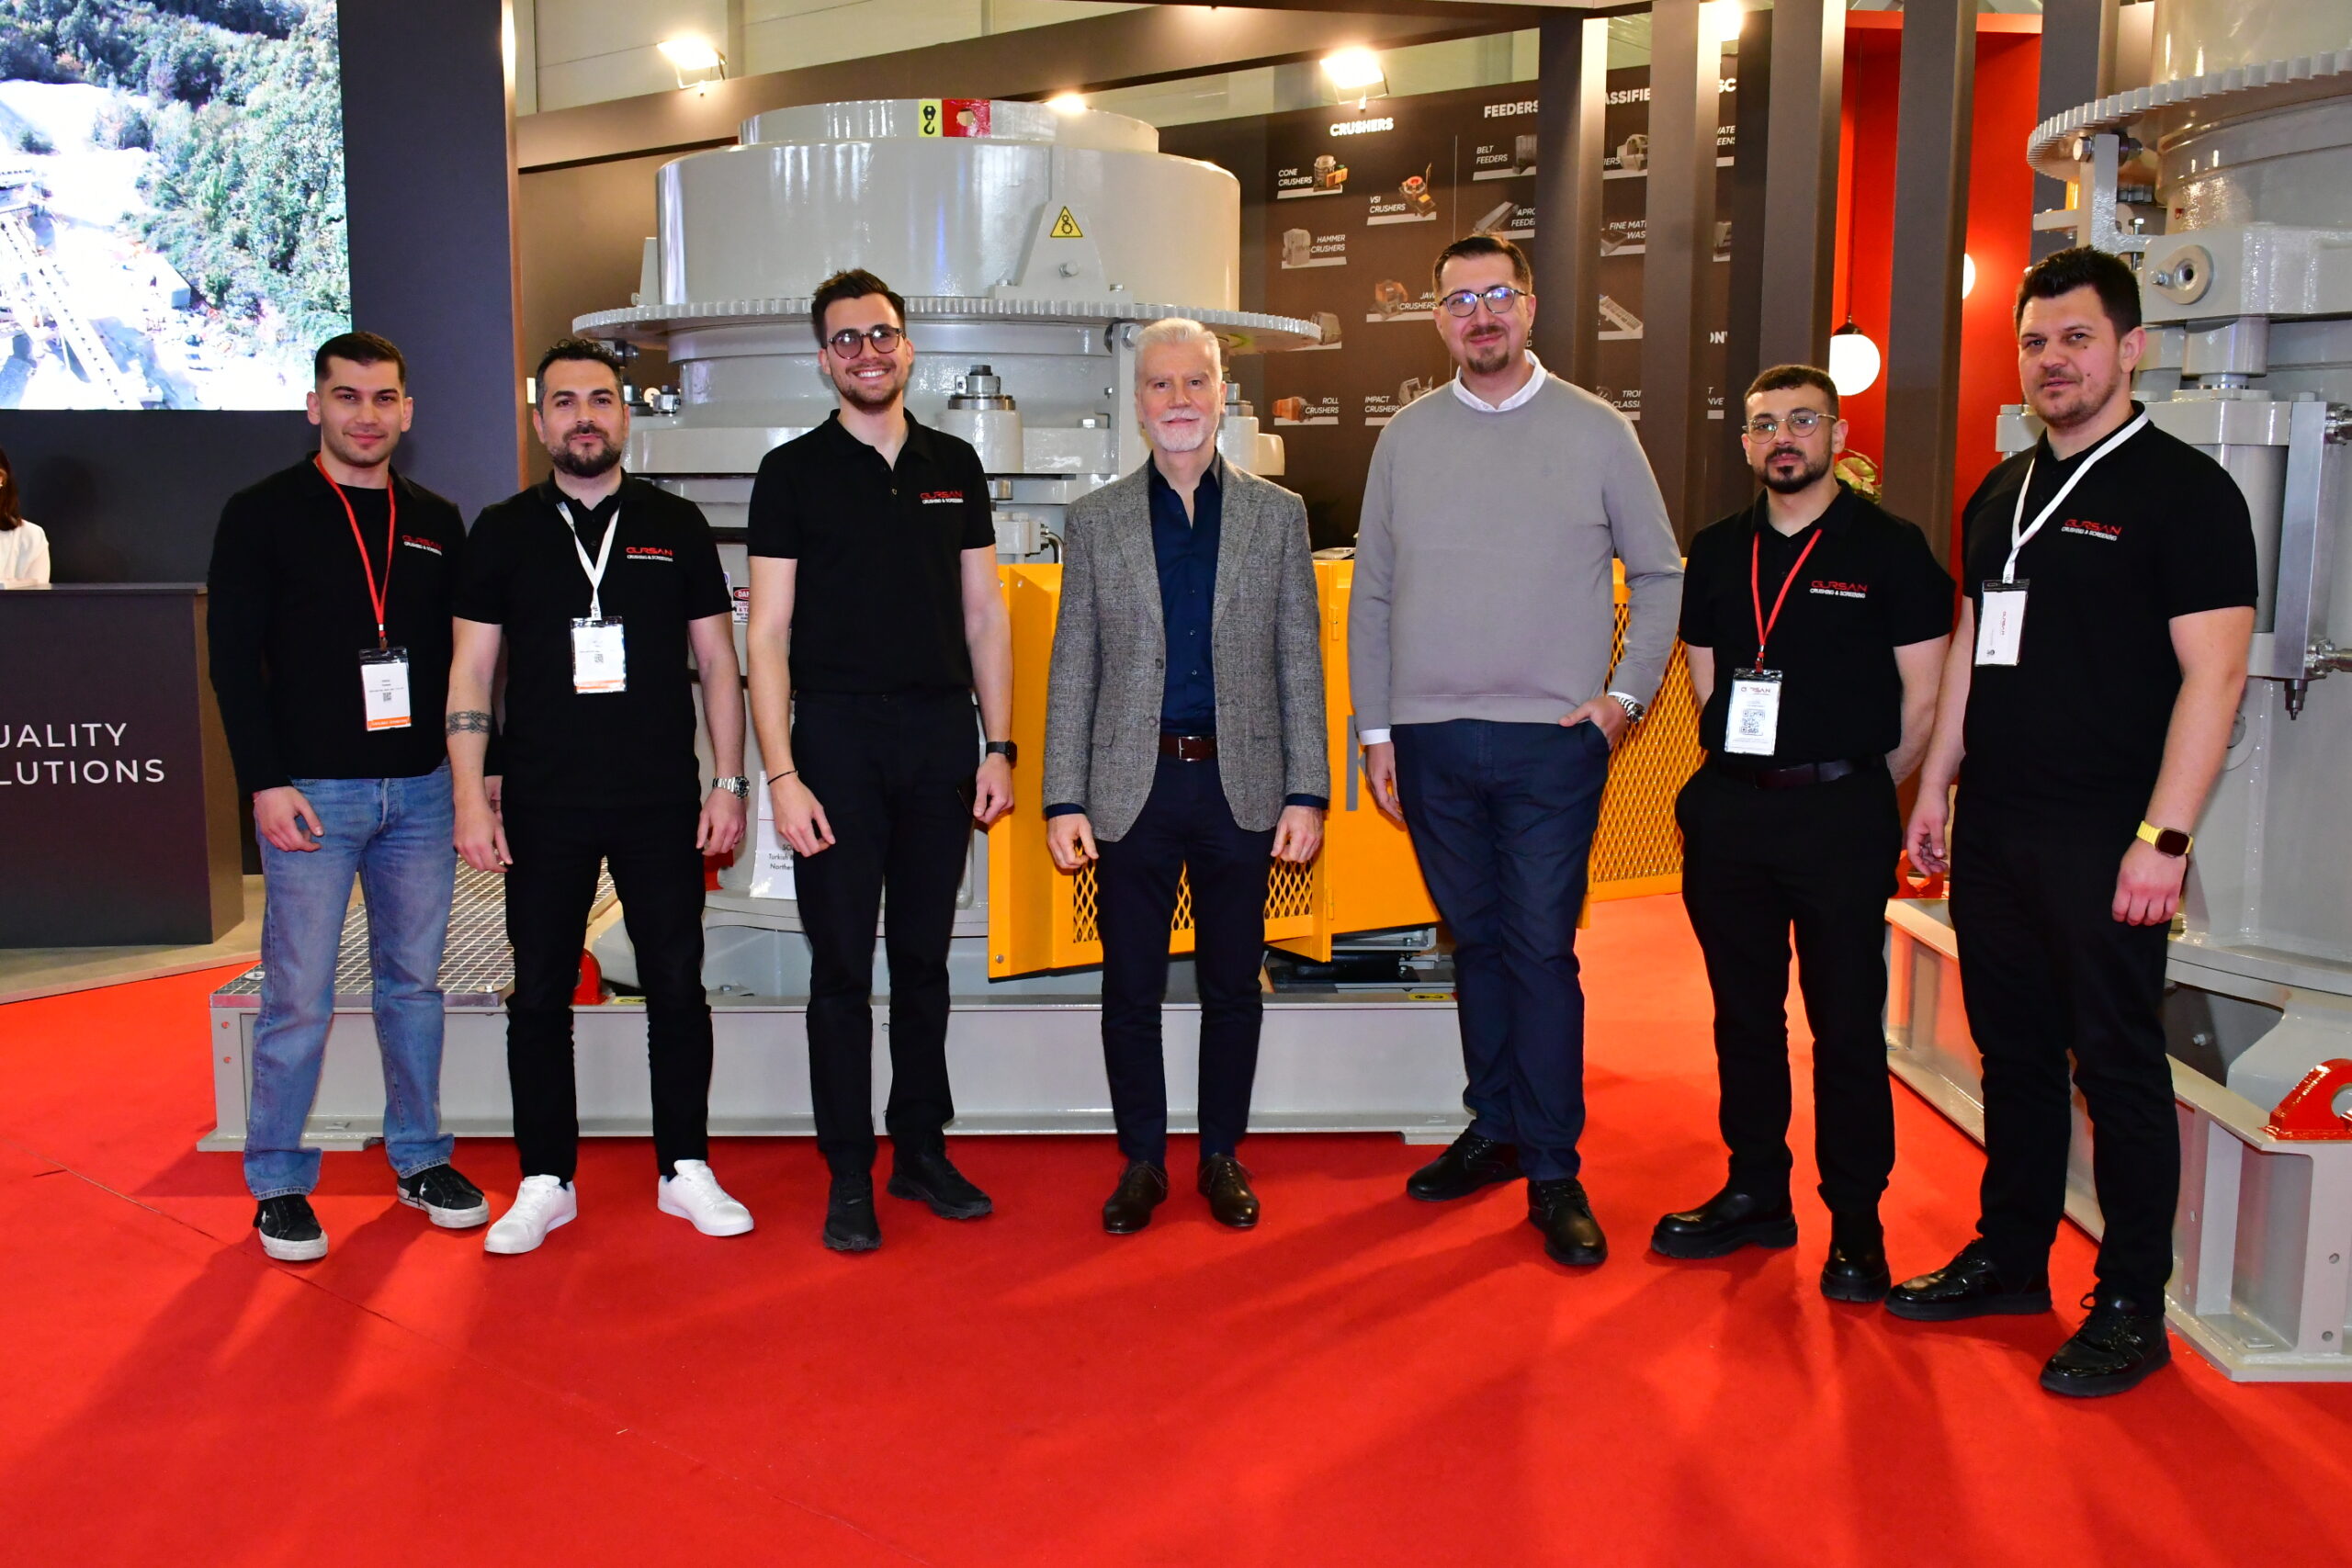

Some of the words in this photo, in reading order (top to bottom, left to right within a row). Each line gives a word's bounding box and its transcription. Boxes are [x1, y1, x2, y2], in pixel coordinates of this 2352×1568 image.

[1485, 100, 1539, 118] FEEDERS
[1329, 118, 1394, 137] CRUSHERS
[1717, 126, 1736, 134] ATE
[1476, 145, 1494, 154] BELT
[1476, 154, 1508, 164] FEEDERS
[1278, 168, 1298, 177] CONE
[1278, 176, 1313, 186] CRUSHERS
[1370, 196, 1381, 204] VSI
[1370, 204, 1406, 214] CRUSHERS
[1610, 221, 1627, 230] FINE
[1317, 234, 1346, 243] HAMMER
[1311, 244, 1345, 254] CRUSHERS
[1400, 302, 1437, 310] CRUSHERS
[1365, 405, 1400, 413] CRUSHERS
[2065, 519, 2121, 535] GURSAN
[1812, 581, 1867, 592] GURSAN
